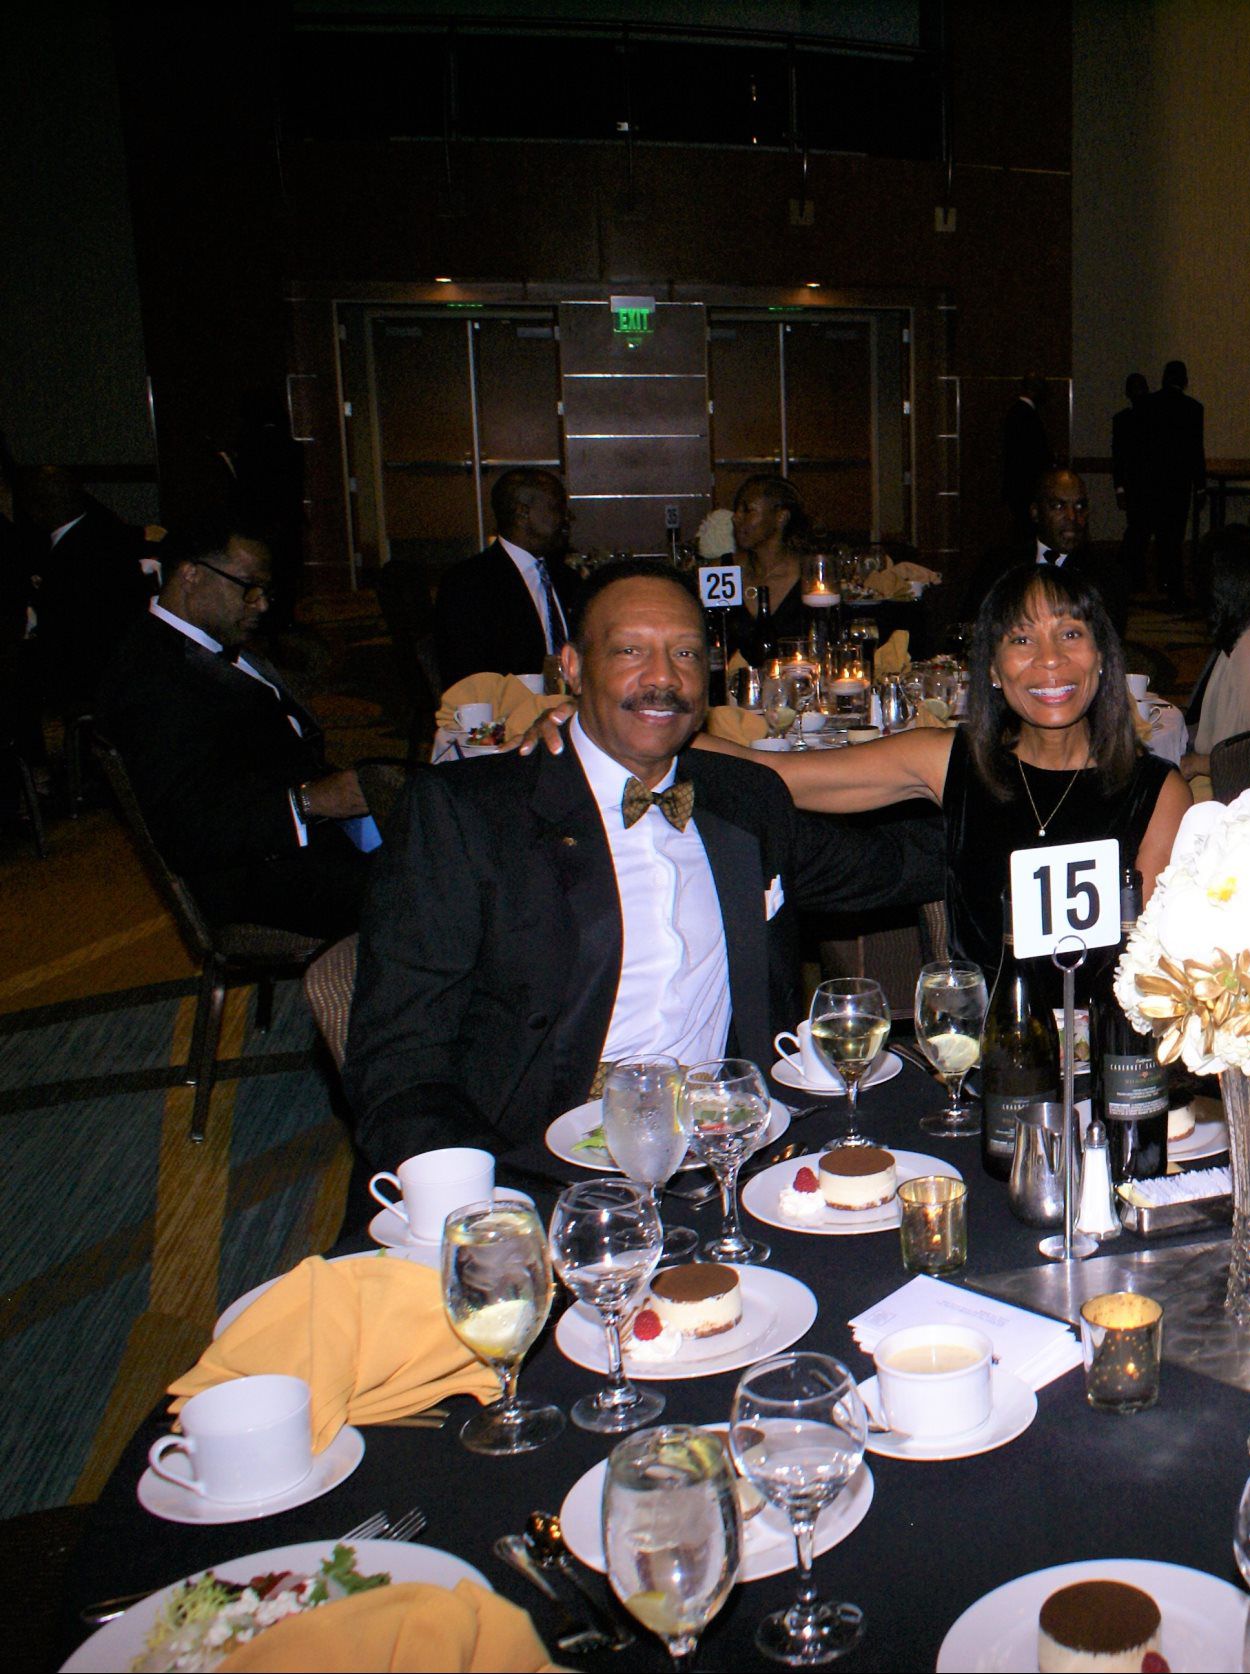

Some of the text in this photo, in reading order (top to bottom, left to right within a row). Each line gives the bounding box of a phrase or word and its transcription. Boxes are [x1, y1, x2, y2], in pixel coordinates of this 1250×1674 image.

[620, 308, 649, 330] EXIT
[706, 572, 735, 599] 25
[1033, 859, 1100, 935] 15
